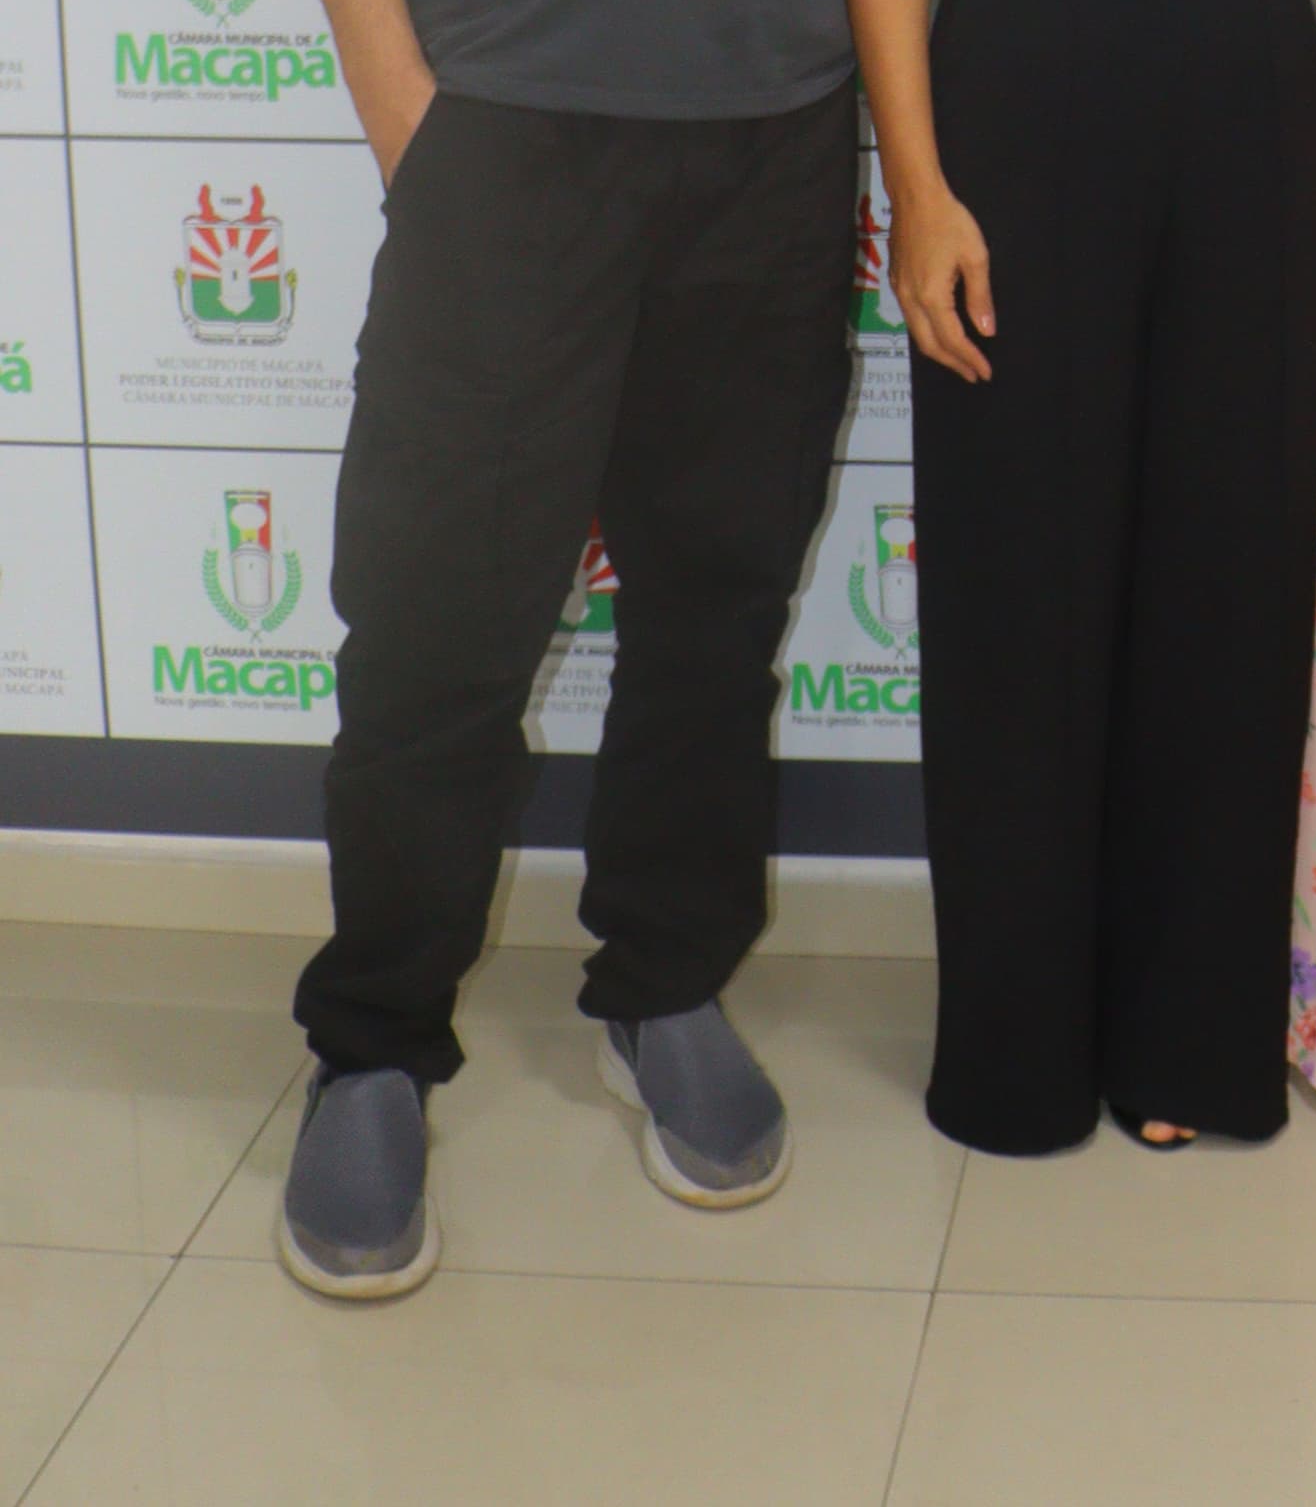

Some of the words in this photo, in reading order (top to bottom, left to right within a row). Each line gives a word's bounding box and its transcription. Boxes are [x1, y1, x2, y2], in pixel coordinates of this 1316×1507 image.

[168, 31, 222, 44] CÂMARA
[226, 33, 291, 46] MUNICIPAL
[295, 34, 312, 45] DE
[115, 33, 335, 102] Macapá
[275, 377, 353, 390] MUNICIPA
[299, 395, 351, 407] MACAP
[203, 645, 255, 658] CÂMARA
[153, 646, 337, 711] Macap
[791, 661, 920, 715] Mac
